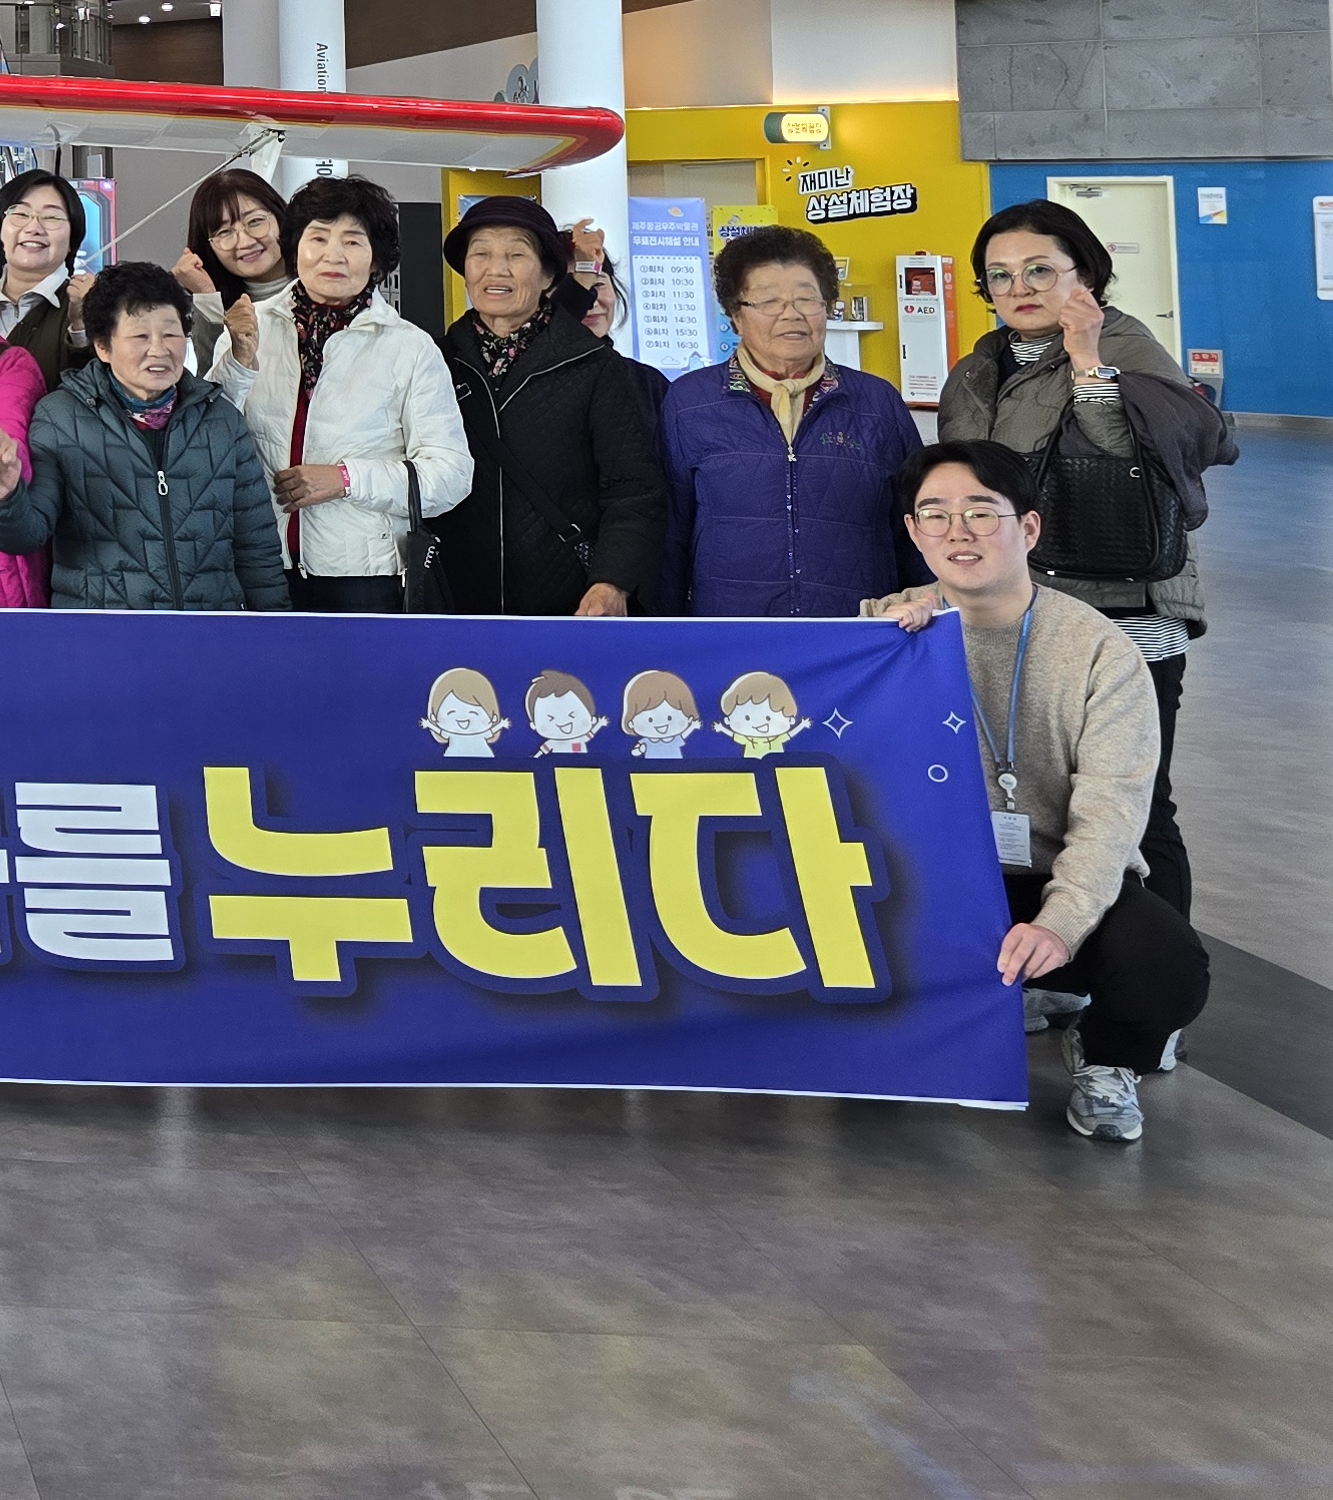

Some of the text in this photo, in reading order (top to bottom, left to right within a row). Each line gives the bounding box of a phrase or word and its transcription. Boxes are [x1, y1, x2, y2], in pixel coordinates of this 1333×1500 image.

[800, 168, 851, 193] 재미난
[807, 184, 914, 220] 상설체험장
[683, 236, 699, 247] 안내
[671, 278, 694, 286] 10:30
[673, 303, 696, 311] 13:30
[917, 306, 935, 314] AED
[674, 316, 697, 324] 14:30
[675, 328, 698, 336] 15:30
[677, 341, 699, 349] 16:30
[203, 766, 872, 989] 누리다
